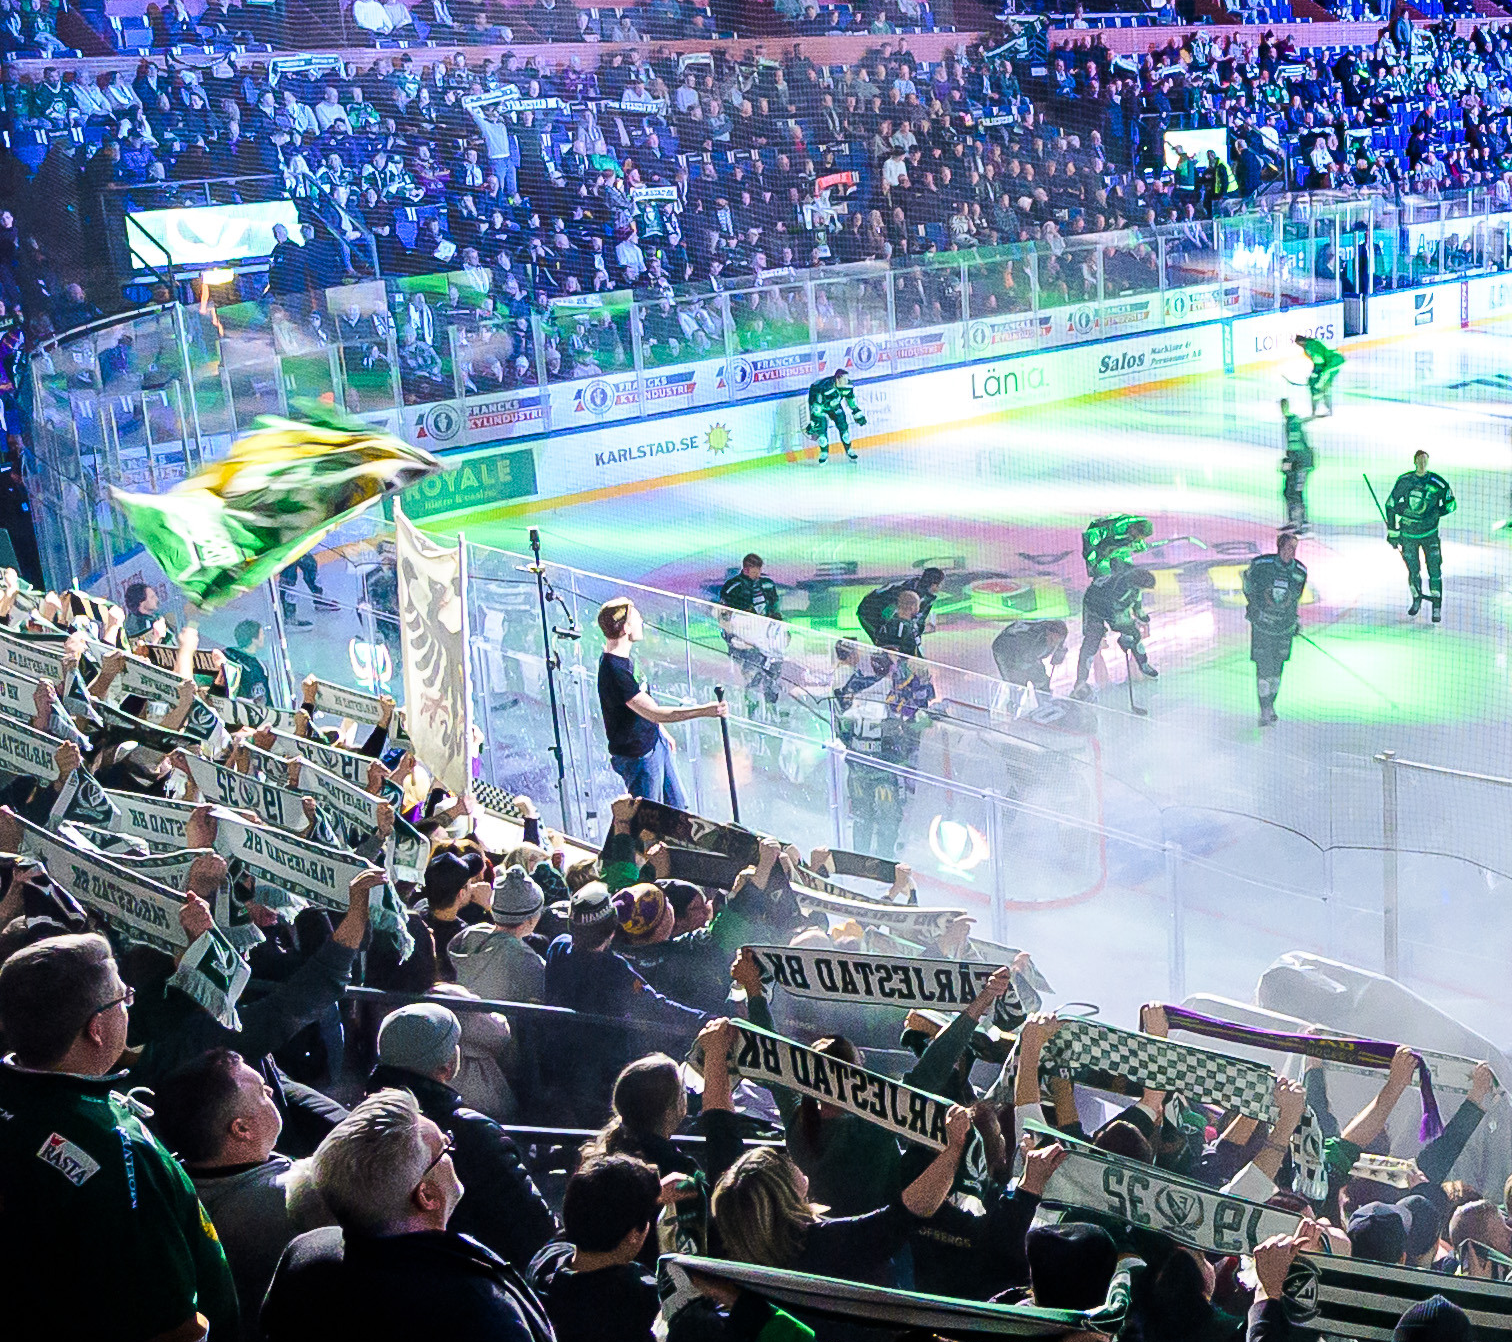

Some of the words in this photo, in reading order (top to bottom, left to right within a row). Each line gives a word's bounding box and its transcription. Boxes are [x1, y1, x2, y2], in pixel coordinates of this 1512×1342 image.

[1098, 352, 1146, 374] Salos
[615, 384, 689, 405] KYLNDUSTRI
[618, 376, 668, 393] FRACKS
[594, 435, 700, 467] KARLSTAD.SE
[42, 1140, 97, 1183] RASTA
